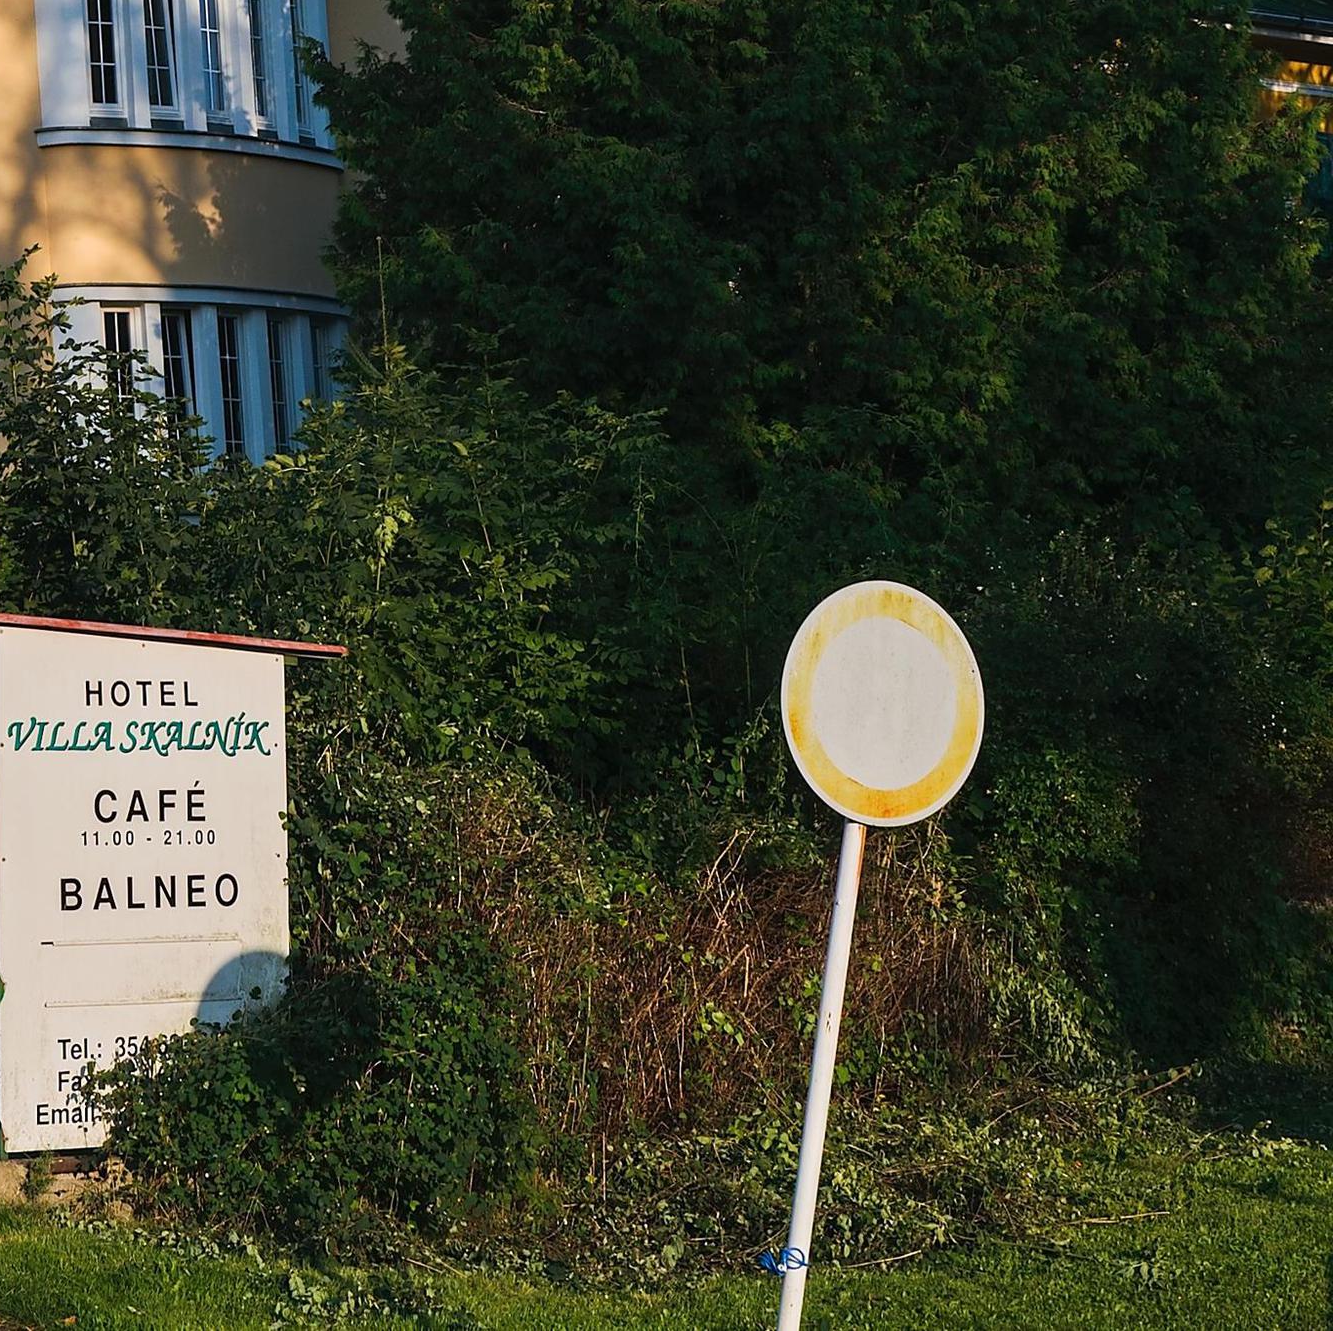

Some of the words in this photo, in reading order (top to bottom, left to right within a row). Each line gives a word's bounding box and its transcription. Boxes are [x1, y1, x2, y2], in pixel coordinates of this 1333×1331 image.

[84, 679, 199, 707] HOTEL
[7, 717, 115, 752] VILLA
[118, 712, 272, 757] SKALNÍK
[93, 780, 207, 823] CAFÉ
[80, 829, 135, 847] 11.00
[163, 829, 216, 846] 21.00
[60, 873, 239, 912] BALNEO
[57, 1038, 102, 1060] Tel.:
